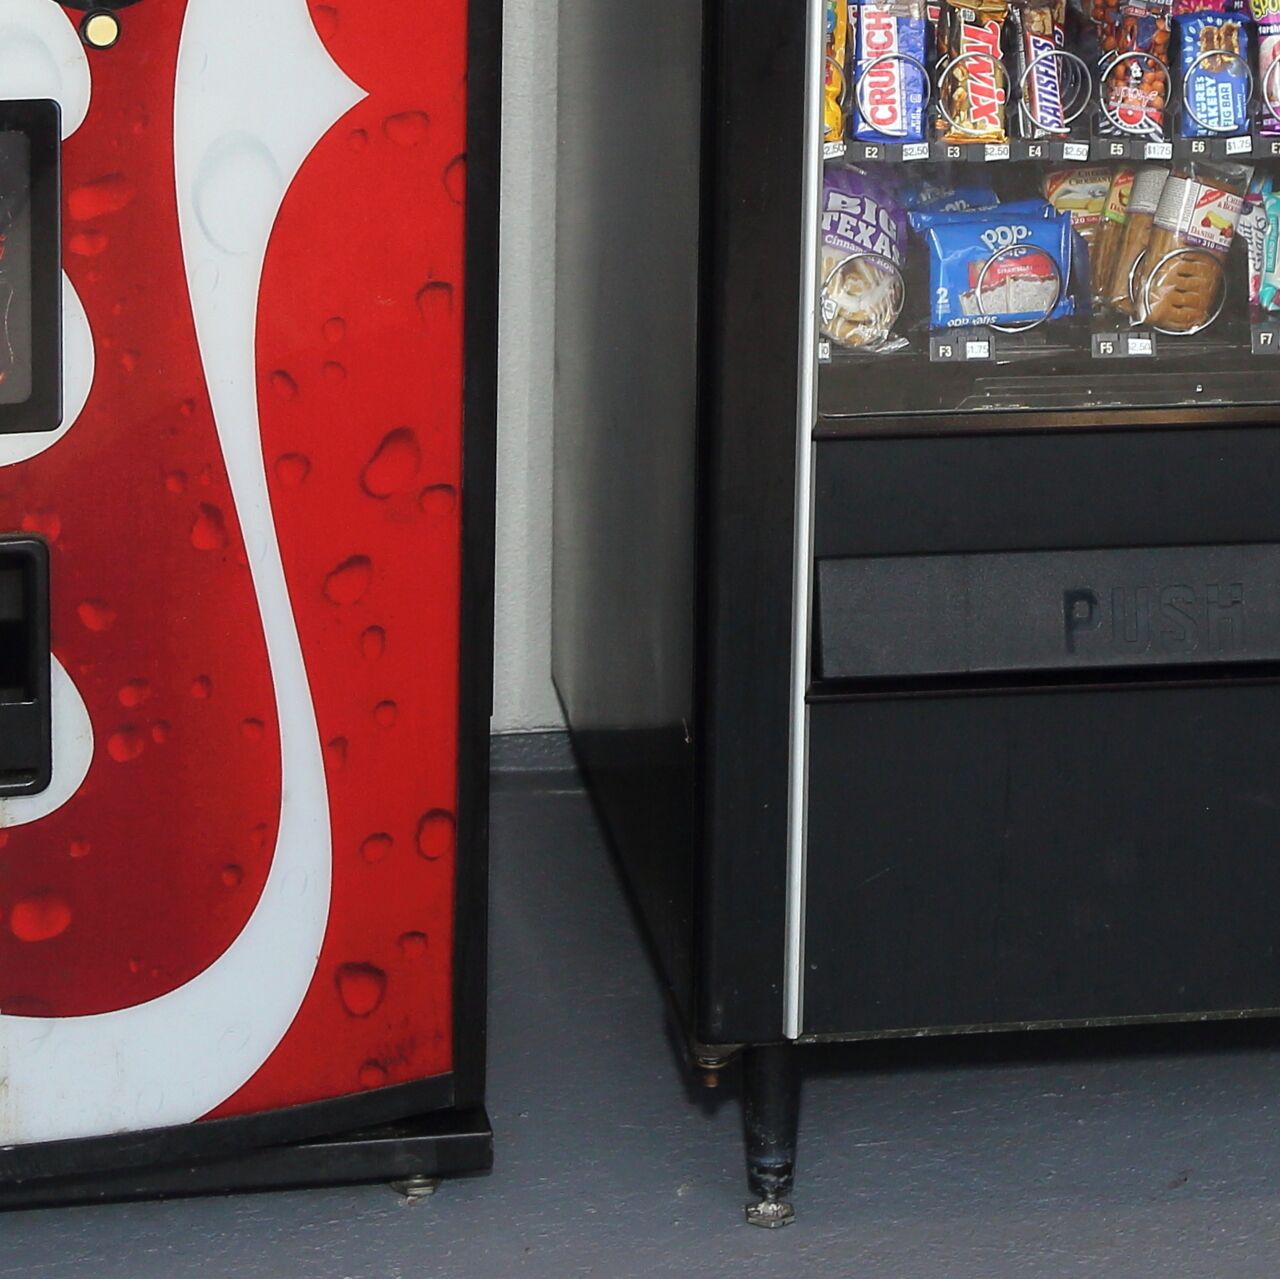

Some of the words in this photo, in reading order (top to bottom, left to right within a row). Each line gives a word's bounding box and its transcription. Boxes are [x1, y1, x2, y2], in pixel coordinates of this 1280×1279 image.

[862, 4, 902, 127] CRUNCH
[1032, 36, 1062, 133] SATISFIES
[1220, 84, 1232, 106] BAR
[824, 144, 844, 156] 2.50
[865, 146, 878, 158] E2
[903, 146, 928, 157] $2.50
[948, 146, 960, 158] E3
[985, 146, 1009, 156] $2.50
[1028, 145, 1041, 158] E4
[1064, 146, 1088, 156] $2.50
[1110, 143, 1123, 155] E5
[1147, 146, 1171, 156] $1.75
[1192, 141, 1204, 152] E6
[1227, 140, 1251, 151] $1.75
[826, 191, 898, 240] BIG
[822, 210, 900, 264] TEXAS
[1191, 226, 1216, 241] DANISH
[936, 288, 949, 303] 2
[1260, 333, 1272, 344] F7
[939, 345, 952, 357] F3
[1100, 343, 1113, 354] F5
[1063, 583, 1244, 656] PUSH
